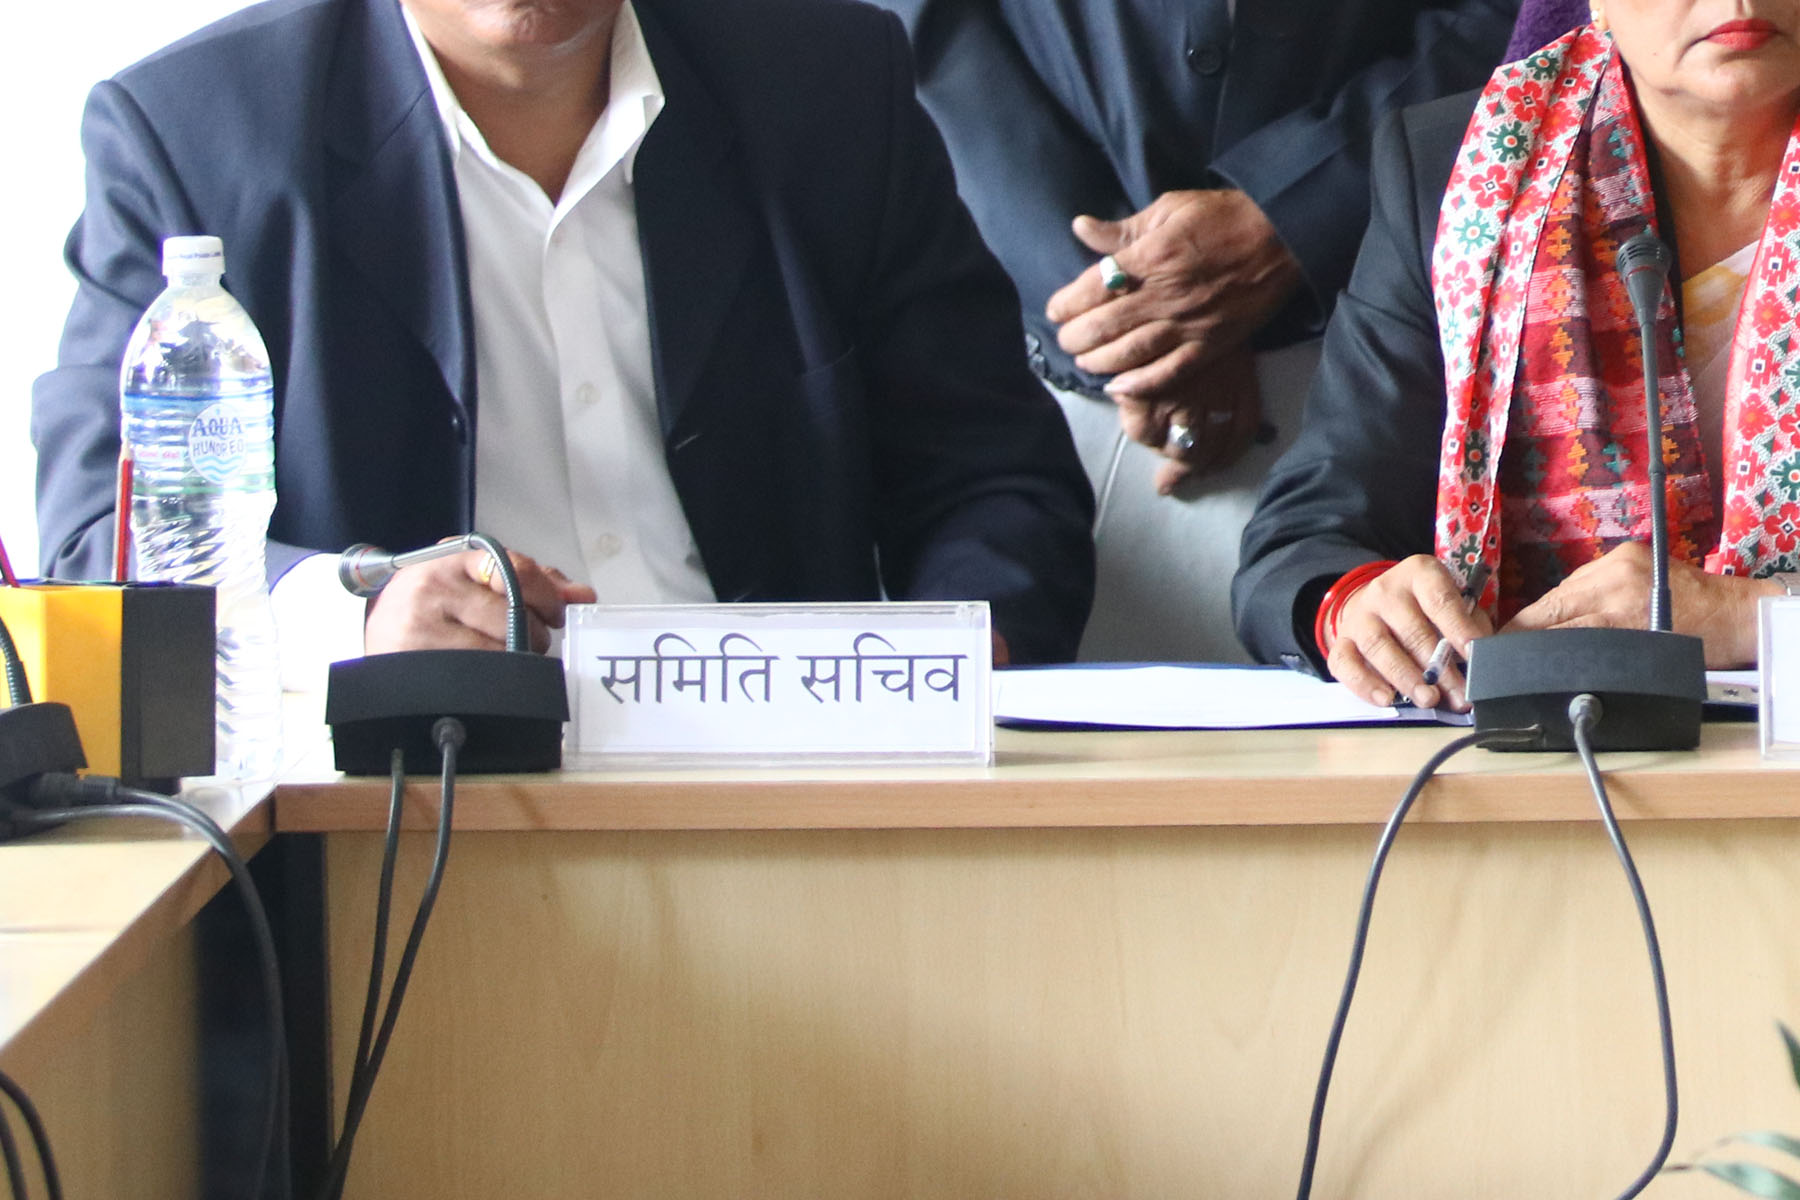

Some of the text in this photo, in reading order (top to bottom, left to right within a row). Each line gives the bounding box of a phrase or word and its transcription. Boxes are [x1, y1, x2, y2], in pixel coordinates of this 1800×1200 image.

[192, 416, 243, 440] AQUA
[596, 632, 968, 704] समिति सचिव
